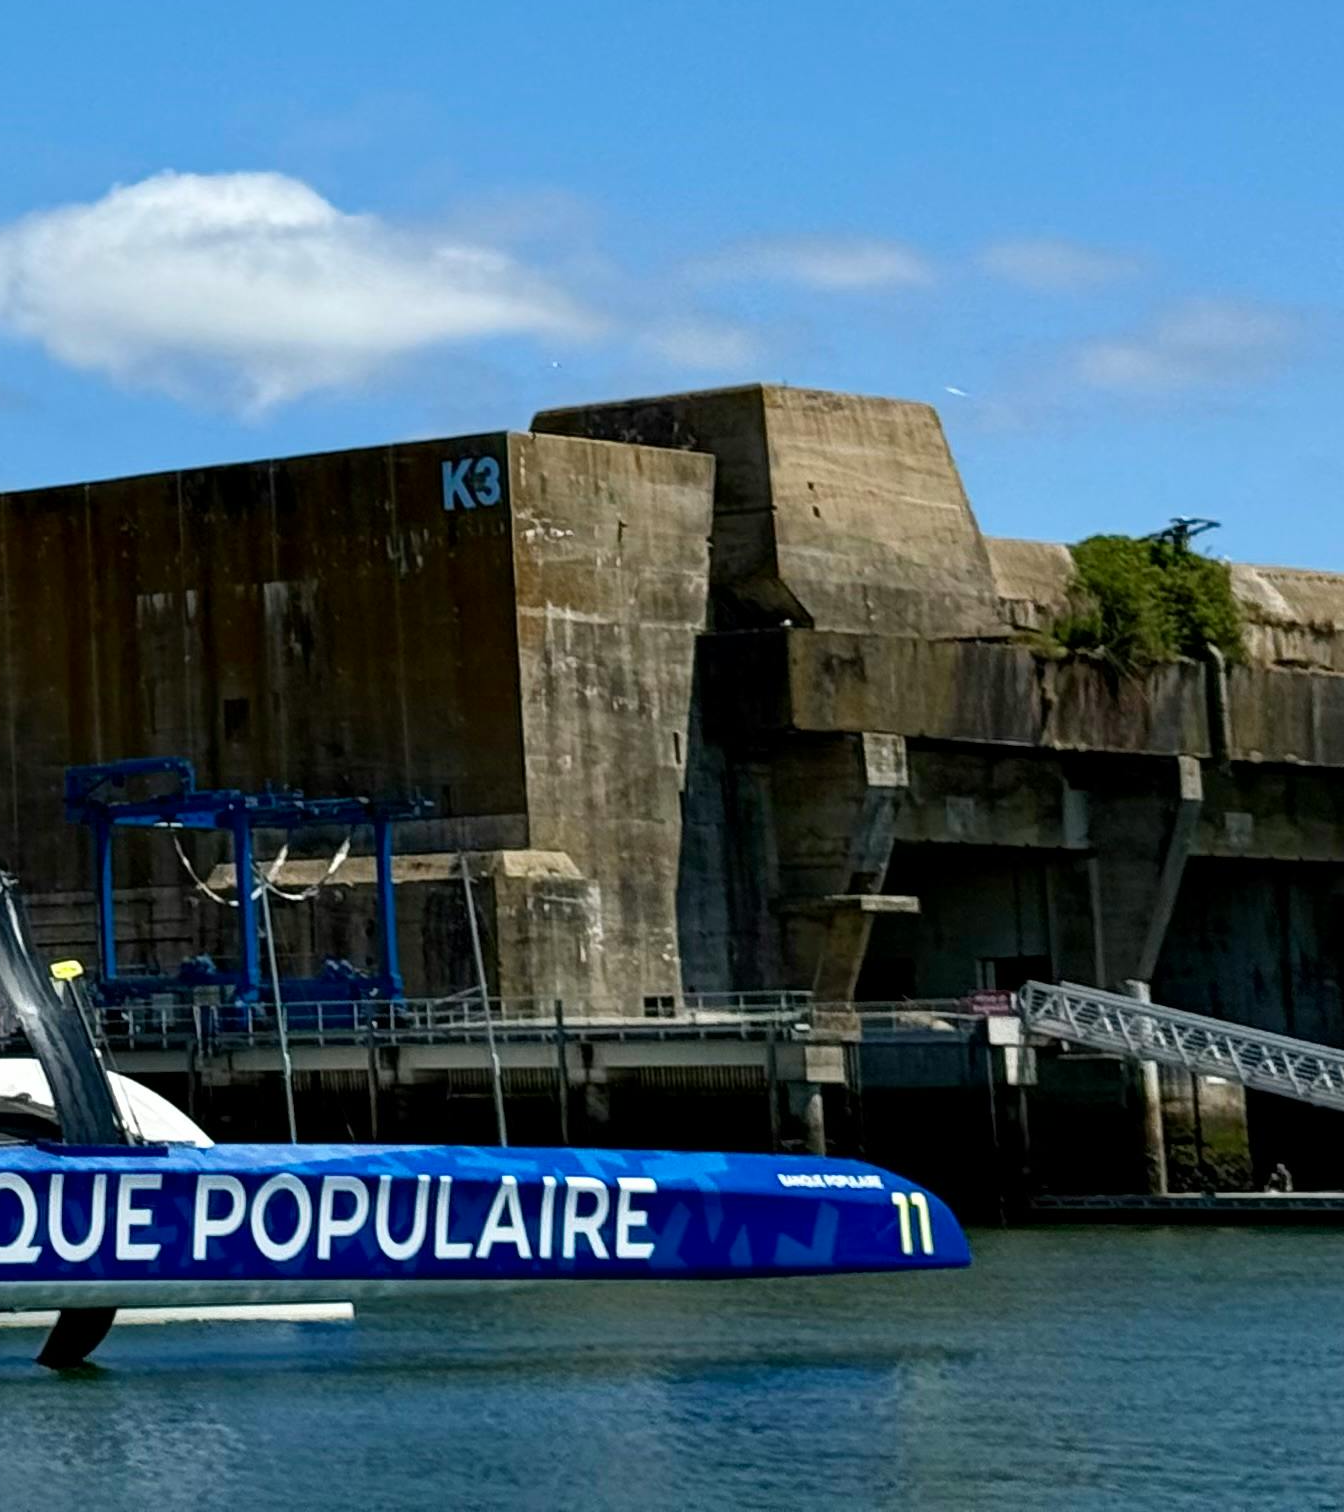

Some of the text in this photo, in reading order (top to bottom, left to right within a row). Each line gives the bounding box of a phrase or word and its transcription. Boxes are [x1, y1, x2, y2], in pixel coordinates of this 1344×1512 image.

[441, 456, 501, 511] K3
[193, 1173, 658, 1261] POPULAIRE
[891, 1191, 934, 1256] 11
